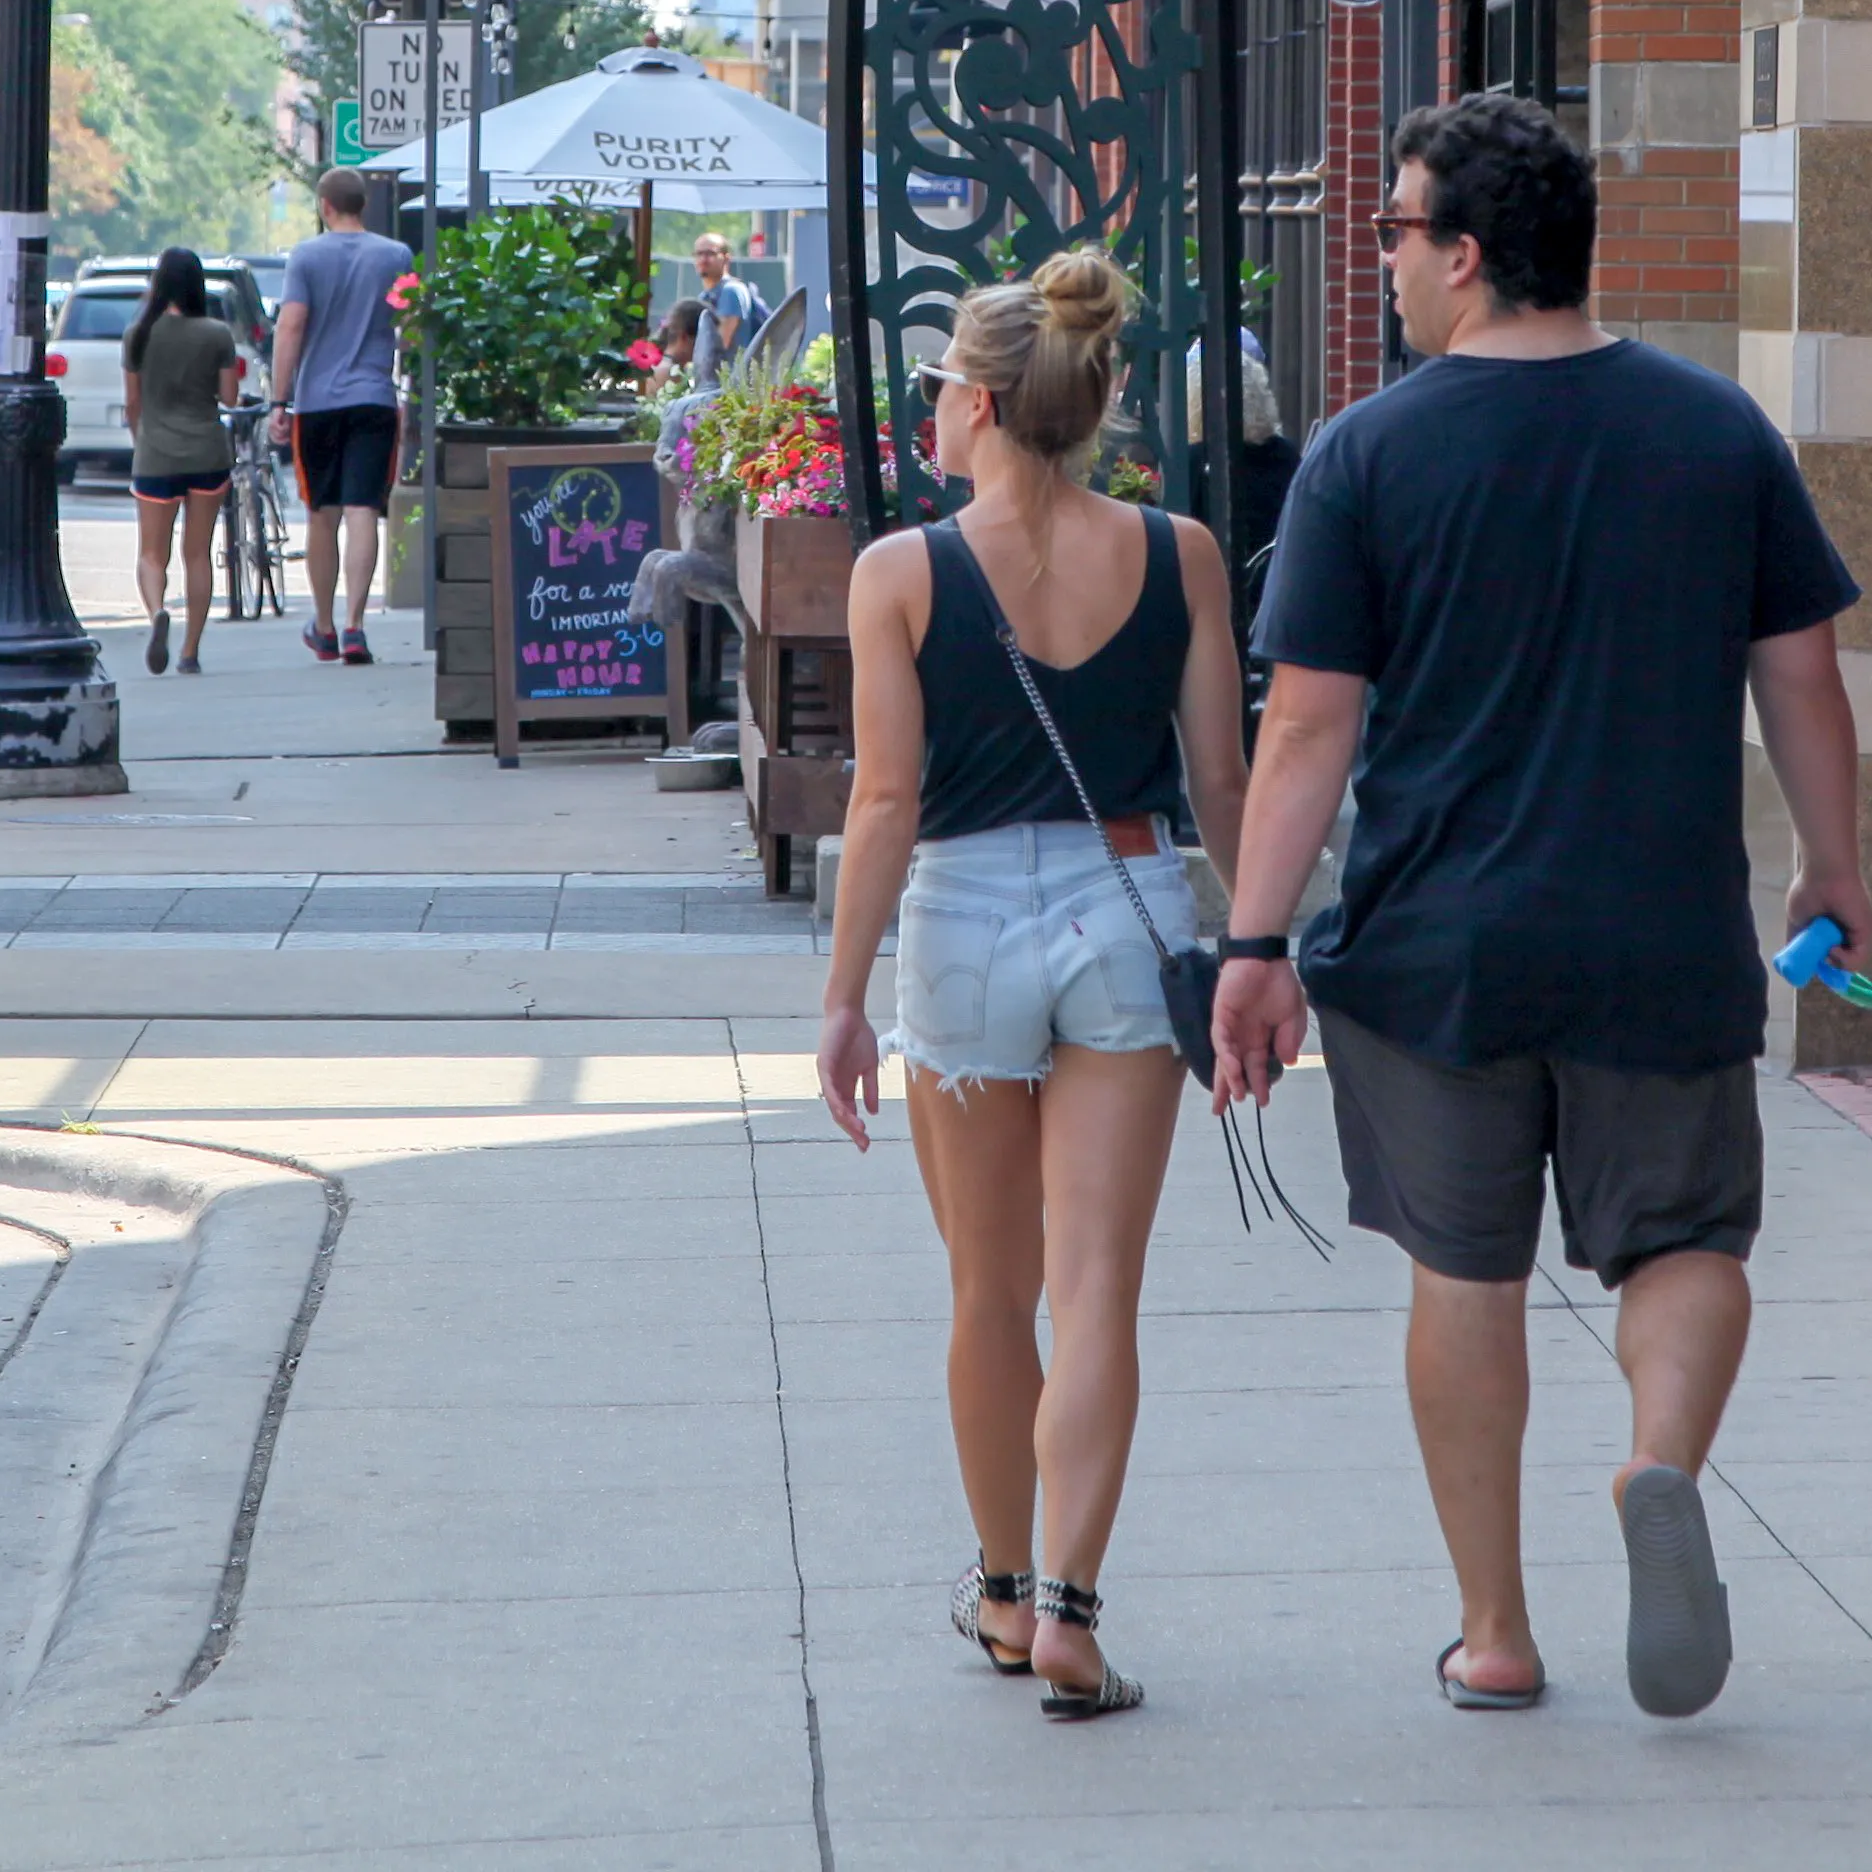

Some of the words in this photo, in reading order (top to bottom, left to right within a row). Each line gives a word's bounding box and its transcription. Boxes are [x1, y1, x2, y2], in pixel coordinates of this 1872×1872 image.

[388, 61, 459, 83] TUN
[370, 89, 405, 112] ON
[424, 89, 471, 112] ED
[368, 117, 405, 135] 7AM
[593, 131, 732, 154] PURITY
[598, 151, 733, 173] VODKA
[548, 519, 649, 568] LATE
[527, 576, 572, 620] for
[579, 585, 595, 600] a
[551, 608, 631, 631] IMPORTAN
[556, 661, 642, 689] HOUR
